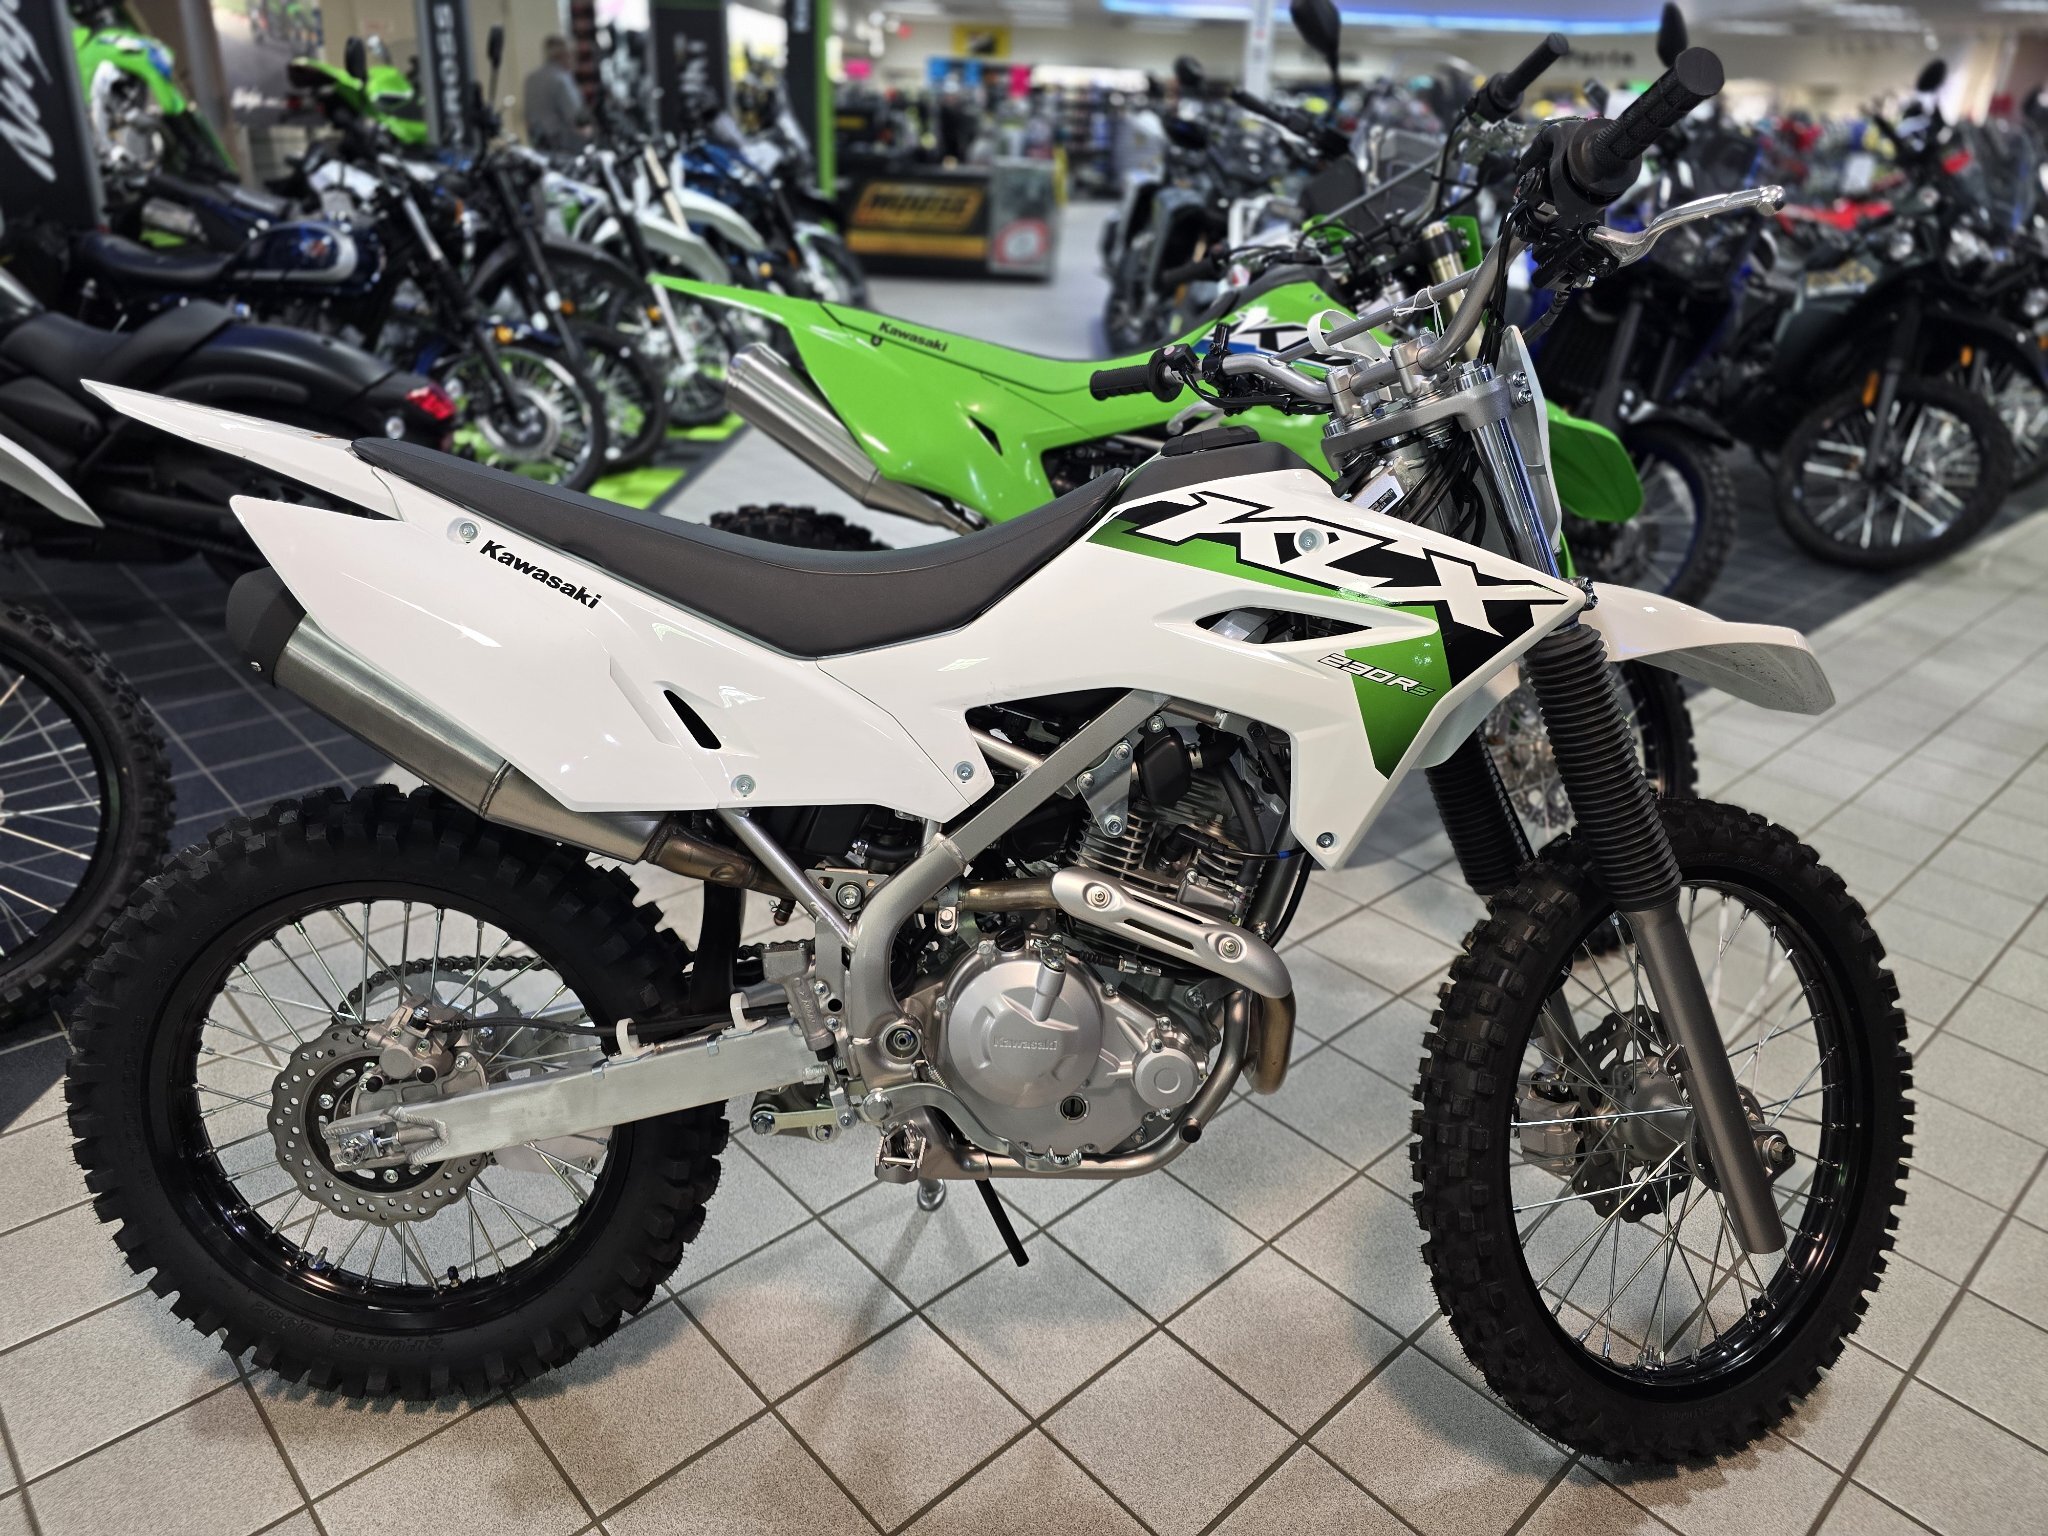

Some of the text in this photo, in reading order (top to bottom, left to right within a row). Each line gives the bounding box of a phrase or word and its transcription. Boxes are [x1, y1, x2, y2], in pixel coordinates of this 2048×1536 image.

[878, 321, 949, 353] Kawasaki
[479, 539, 603, 610] Kawasaki
[1122, 490, 1568, 638] KLX
[992, 1034, 1059, 1052] Kawasaki
